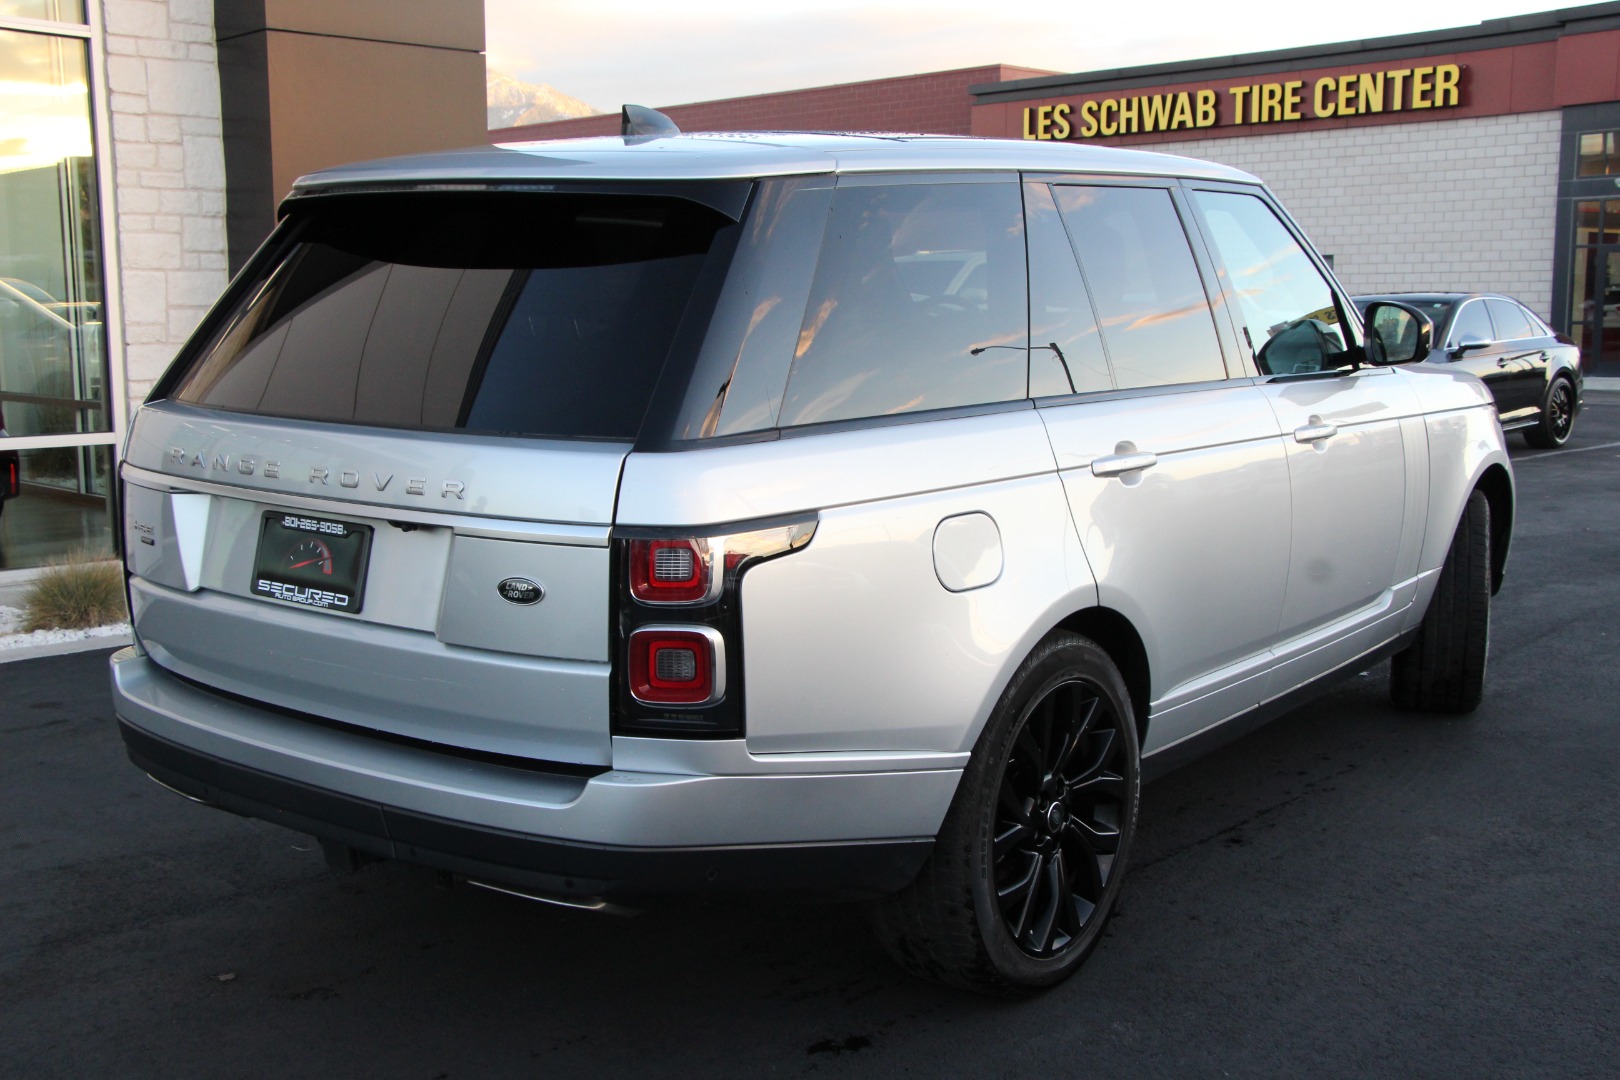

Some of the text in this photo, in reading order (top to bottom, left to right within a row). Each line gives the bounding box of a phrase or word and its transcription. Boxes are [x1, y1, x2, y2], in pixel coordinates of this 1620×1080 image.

[1023, 63, 1460, 140] LES SCHWAB TIRE CENTER
[170, 447, 466, 500] RANGE ROVER
[257, 579, 349, 606] SECURED
[506, 581, 528, 591] LAND
[507, 590, 535, 599] ROVER
